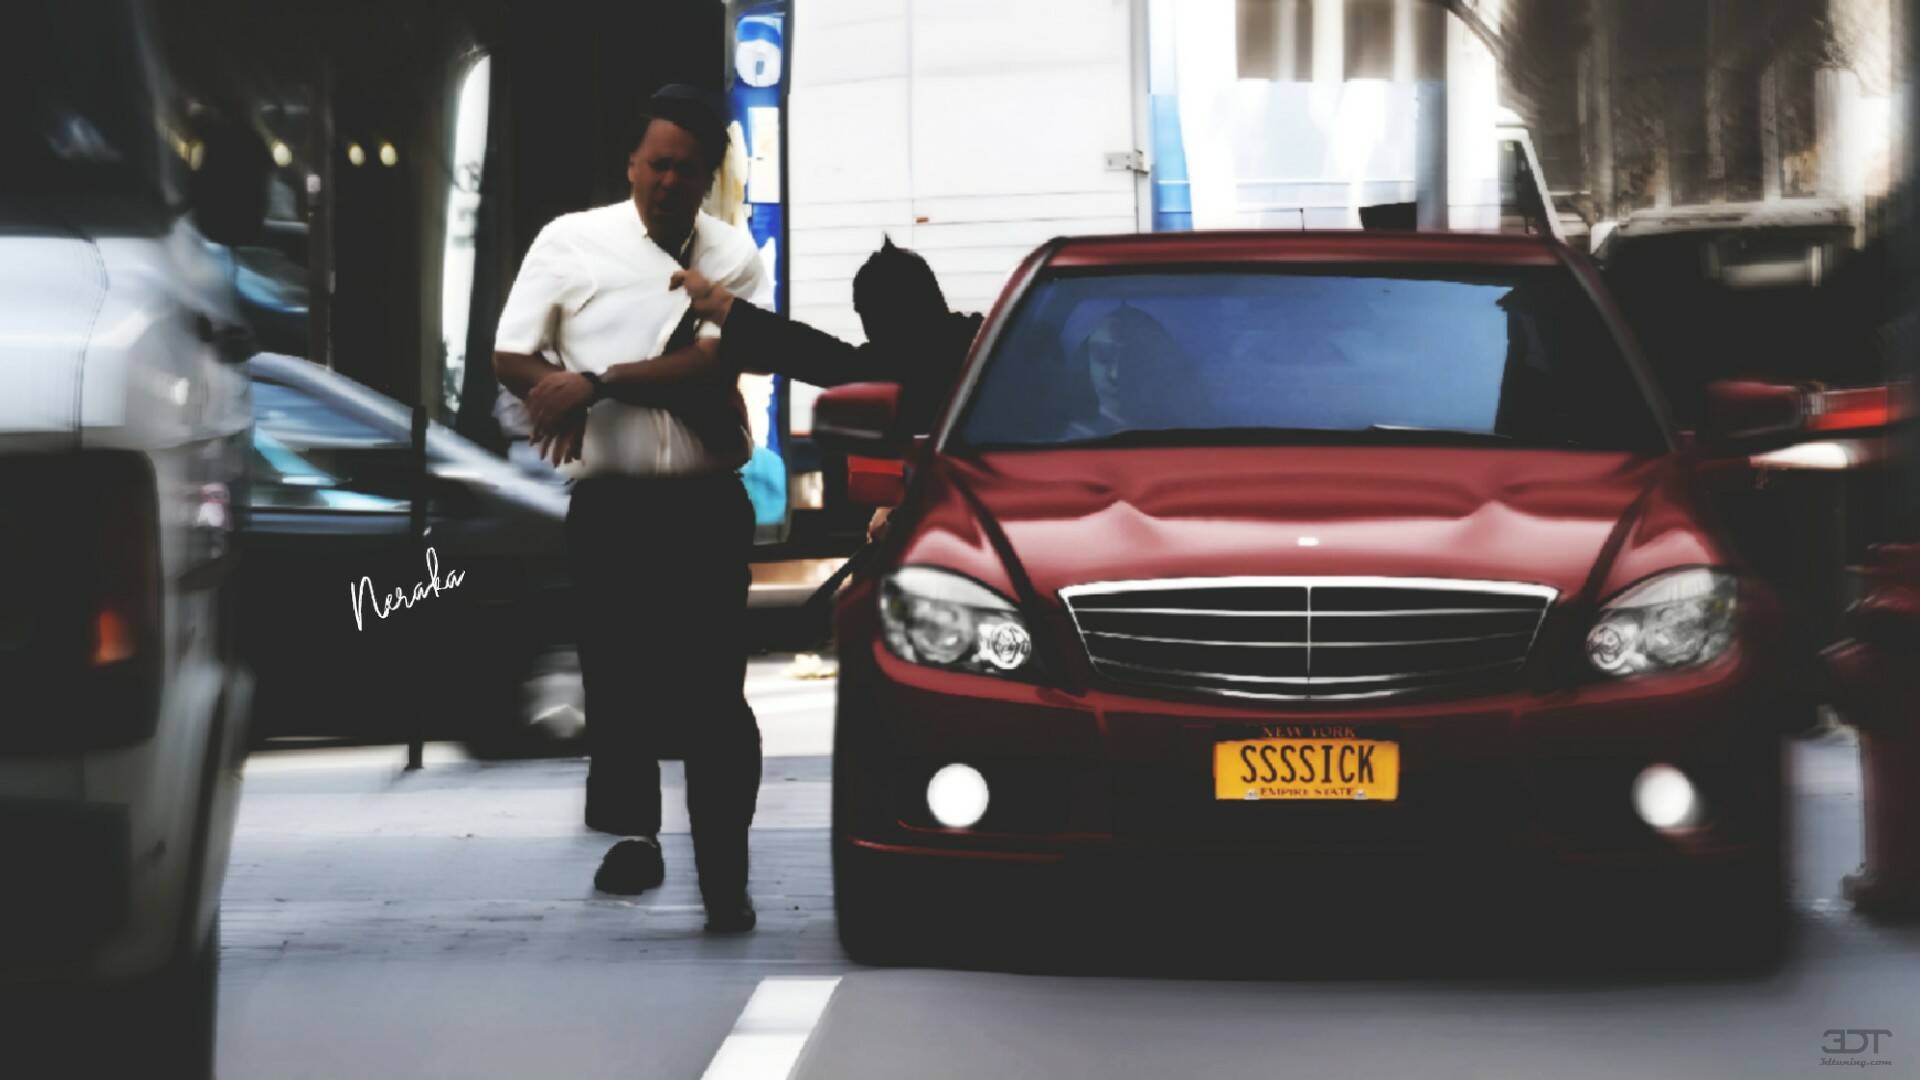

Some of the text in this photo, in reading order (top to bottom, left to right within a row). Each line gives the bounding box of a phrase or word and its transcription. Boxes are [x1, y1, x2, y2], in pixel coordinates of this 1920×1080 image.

[1263, 726, 1356, 738] NEW YORK
[1240, 744, 1376, 784] SSSSICK
[1259, 787, 1355, 797] EMPIRE STATE
